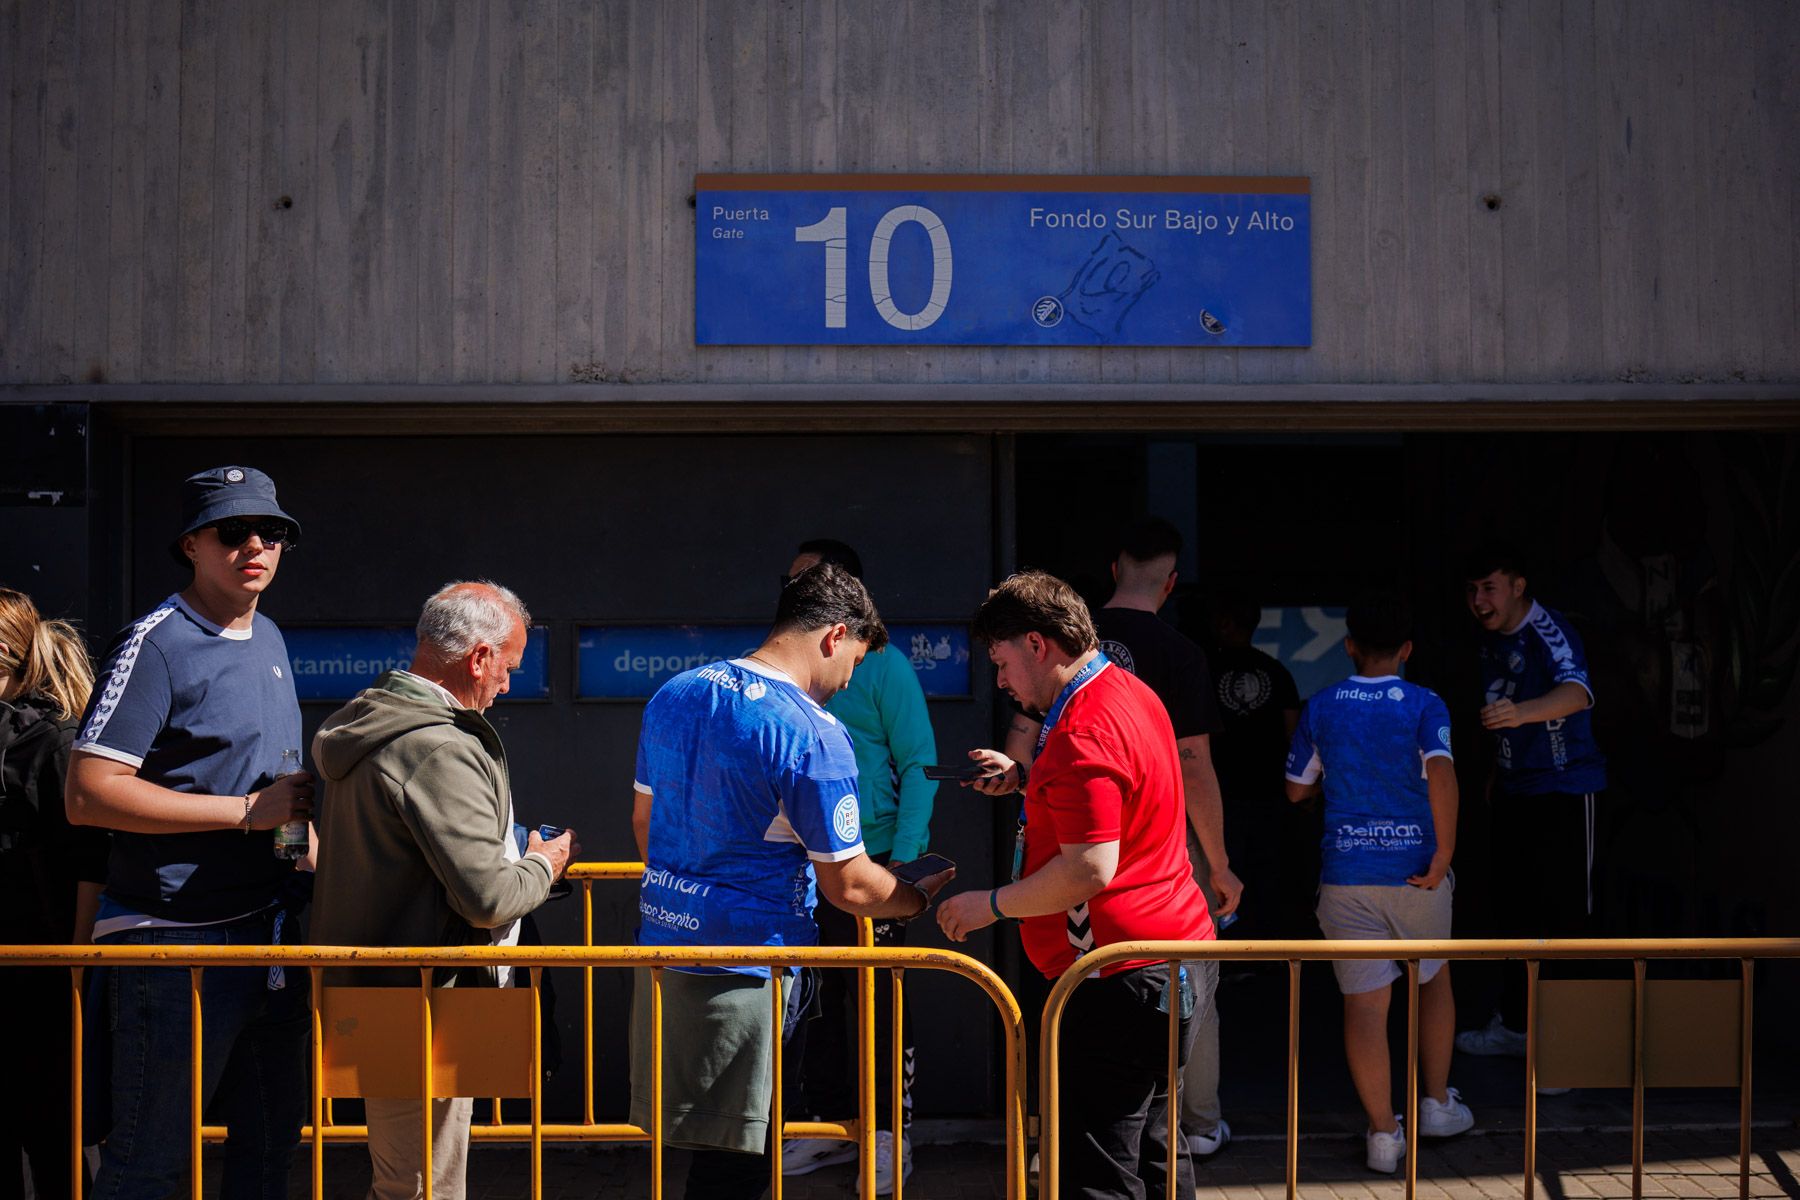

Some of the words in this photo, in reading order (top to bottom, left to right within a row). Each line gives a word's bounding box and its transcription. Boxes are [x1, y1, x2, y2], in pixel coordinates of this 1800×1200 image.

[713, 206, 769, 221] Puerta
[1030, 207, 1107, 229] Fondo
[1115, 208, 1157, 230] Sur
[1165, 210, 1219, 235] Bajo
[1227, 215, 1240, 236] y
[1247, 210, 1295, 232] Alto
[712, 227, 744, 240] Gate
[795, 205, 953, 331] 10
[293, 653, 412, 675] tamiento
[696, 665, 744, 693] indeso
[1336, 687, 1384, 701] indeso
[1037, 723, 1051, 747] XEREZ
[659, 905, 700, 931] benito
